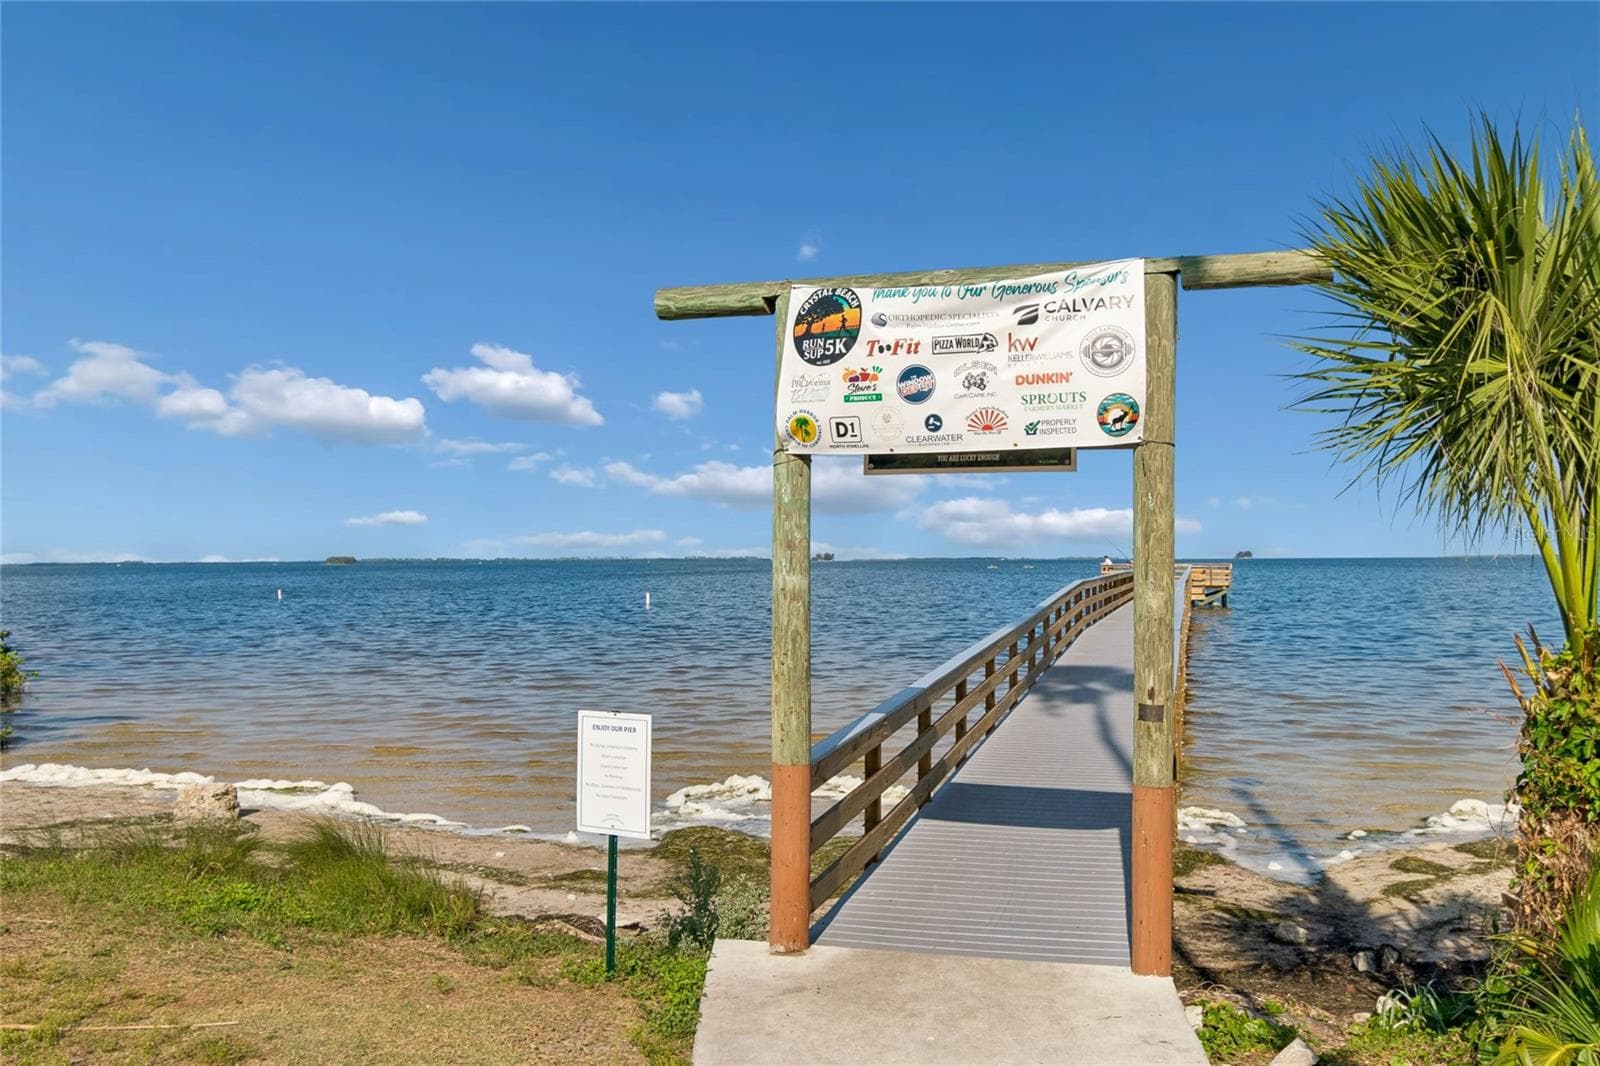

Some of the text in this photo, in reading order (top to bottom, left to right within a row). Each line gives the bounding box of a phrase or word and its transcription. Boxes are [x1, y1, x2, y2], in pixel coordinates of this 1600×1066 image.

[911, 287, 937, 304] you
[957, 283, 987, 300] Our
[991, 280, 1058, 302] Generous
[1063, 270, 1129, 294] Sponsors
[800, 288, 861, 315] CRYSTAL BEACH
[1043, 294, 1135, 313] CALVARY
[888, 313, 947, 322] ORTHOPEDIC
[1045, 314, 1087, 322] CHURCH
[803, 338, 825, 351] RUN
[825, 338, 847, 355] 5K
[934, 336, 980, 351] PIZZA WORLD
[1008, 332, 1038, 352] kw
[803, 349, 824, 360] SUP
[897, 374, 933, 387] WINDOW
[1015, 372, 1073, 386] DUNKIN'
[847, 383, 877, 394] Steve's
[1021, 391, 1087, 406] SPROUTS
[799, 409, 819, 423] HARBOR
[1041, 418, 1077, 427] PROPERLY
[835, 421, 858, 438] D1
[1039, 426, 1078, 435] INSPECTED
[905, 433, 964, 444] CLEARWATER
[592, 723, 637, 734] ENJOY OUR PIER
